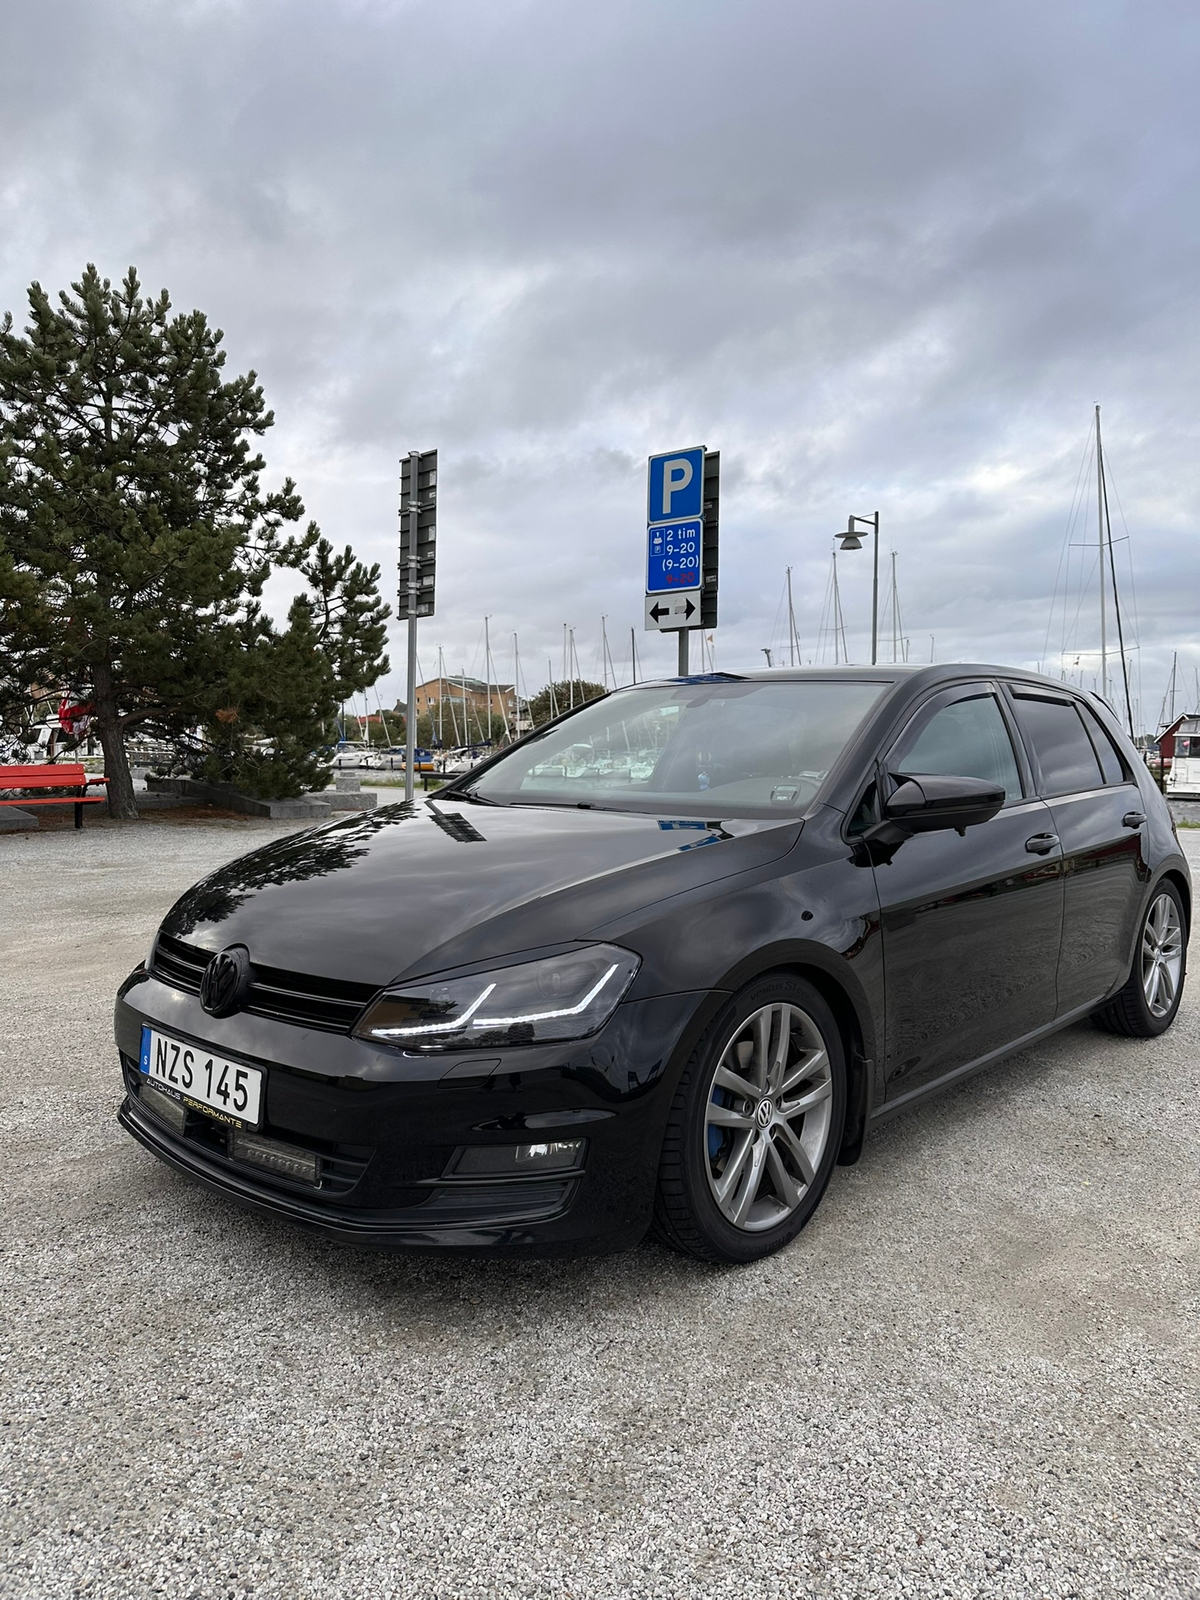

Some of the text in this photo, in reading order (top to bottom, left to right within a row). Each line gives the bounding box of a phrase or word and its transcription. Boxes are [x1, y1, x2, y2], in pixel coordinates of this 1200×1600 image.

[662, 458, 693, 514] P
[666, 527, 695, 541] 2 tim
[666, 541, 695, 555] 9-20
[662, 554, 699, 572] (9-20)
[666, 571, 695, 584] 9-20
[143, 1054, 148, 1066] S
[156, 1037, 249, 1112] NZS 145
[146, 1078, 242, 1129] AUTOHAUS PERFORMANTE
